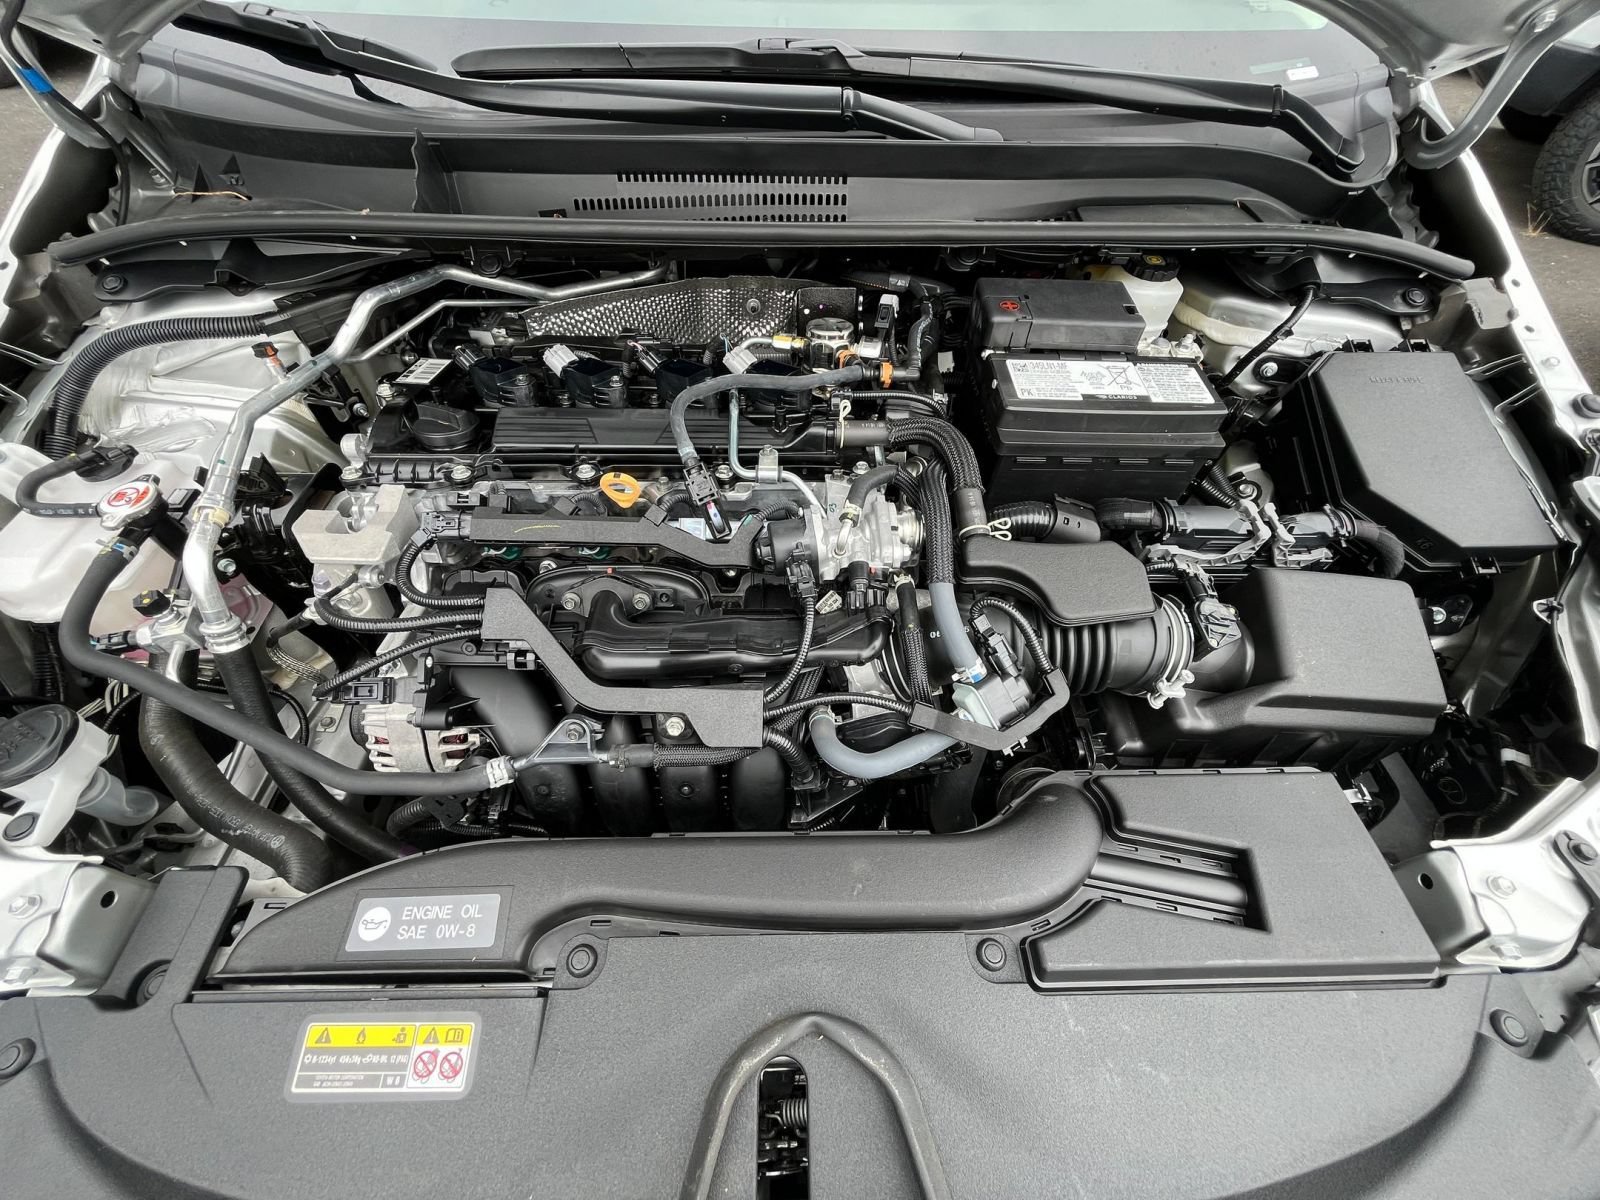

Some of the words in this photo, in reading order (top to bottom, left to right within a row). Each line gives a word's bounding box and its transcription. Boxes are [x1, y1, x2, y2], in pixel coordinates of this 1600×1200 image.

[402, 905, 453, 920] ENGINE
[461, 904, 482, 918] OIL
[397, 925, 427, 940] SAE
[436, 923, 476, 938] 0W-8
